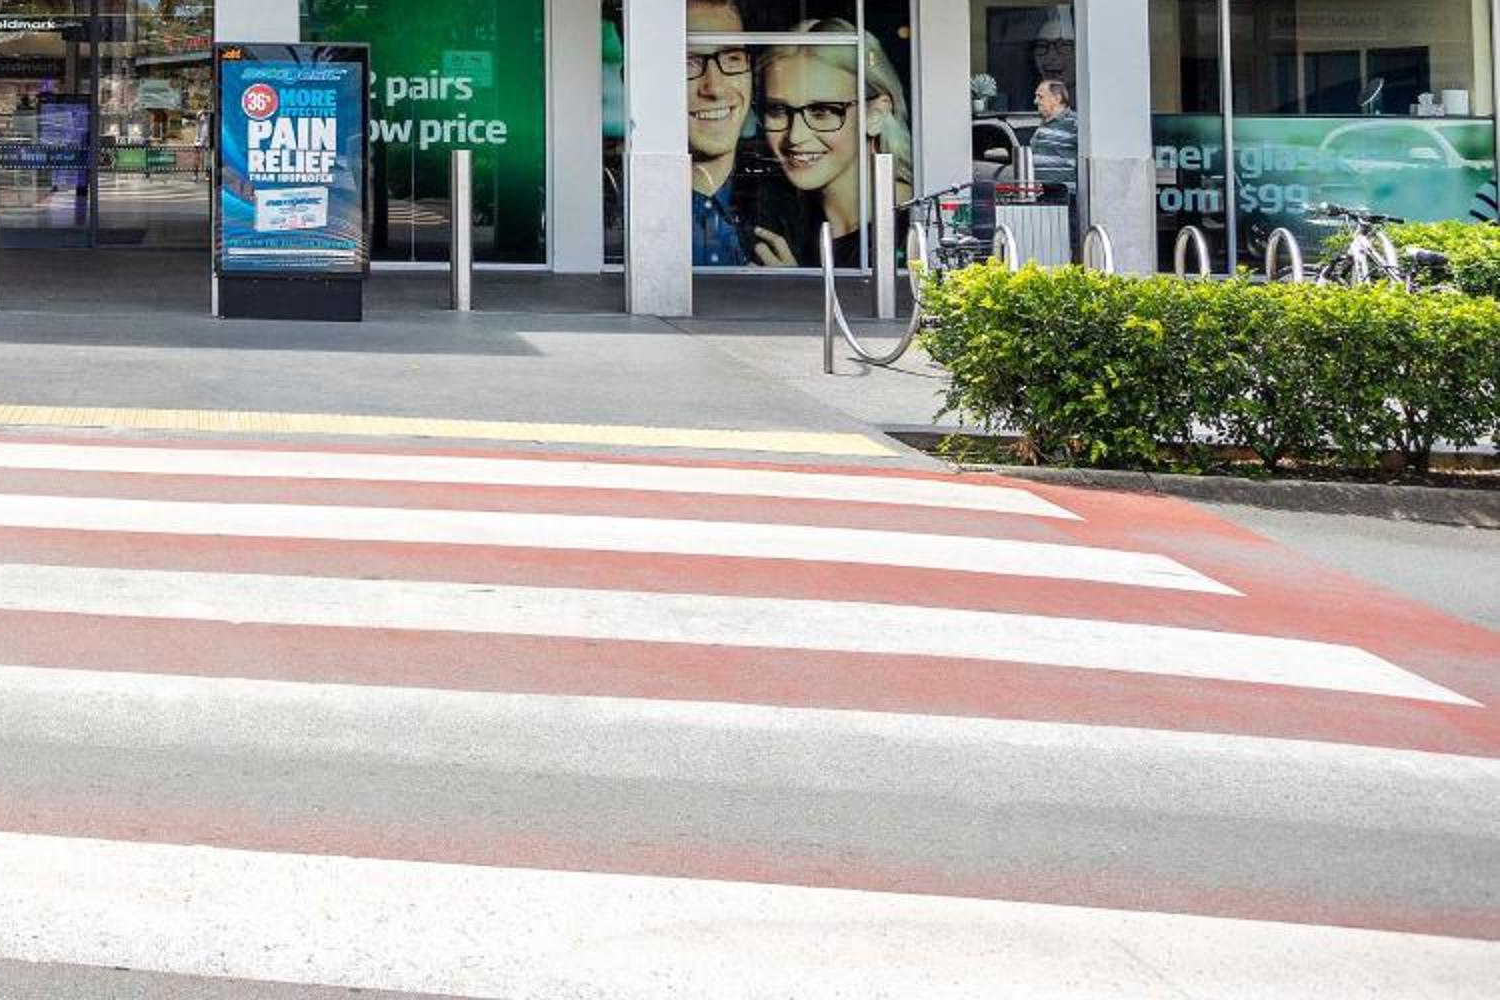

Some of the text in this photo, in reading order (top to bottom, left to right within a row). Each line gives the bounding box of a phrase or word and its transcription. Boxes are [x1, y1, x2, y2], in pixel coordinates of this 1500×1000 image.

[280, 88, 337, 107] MORE
[386, 69, 473, 106] pairs
[248, 117, 337, 150] PAIN
[419, 113, 508, 150] price
[248, 150, 336, 173] RELIEF
